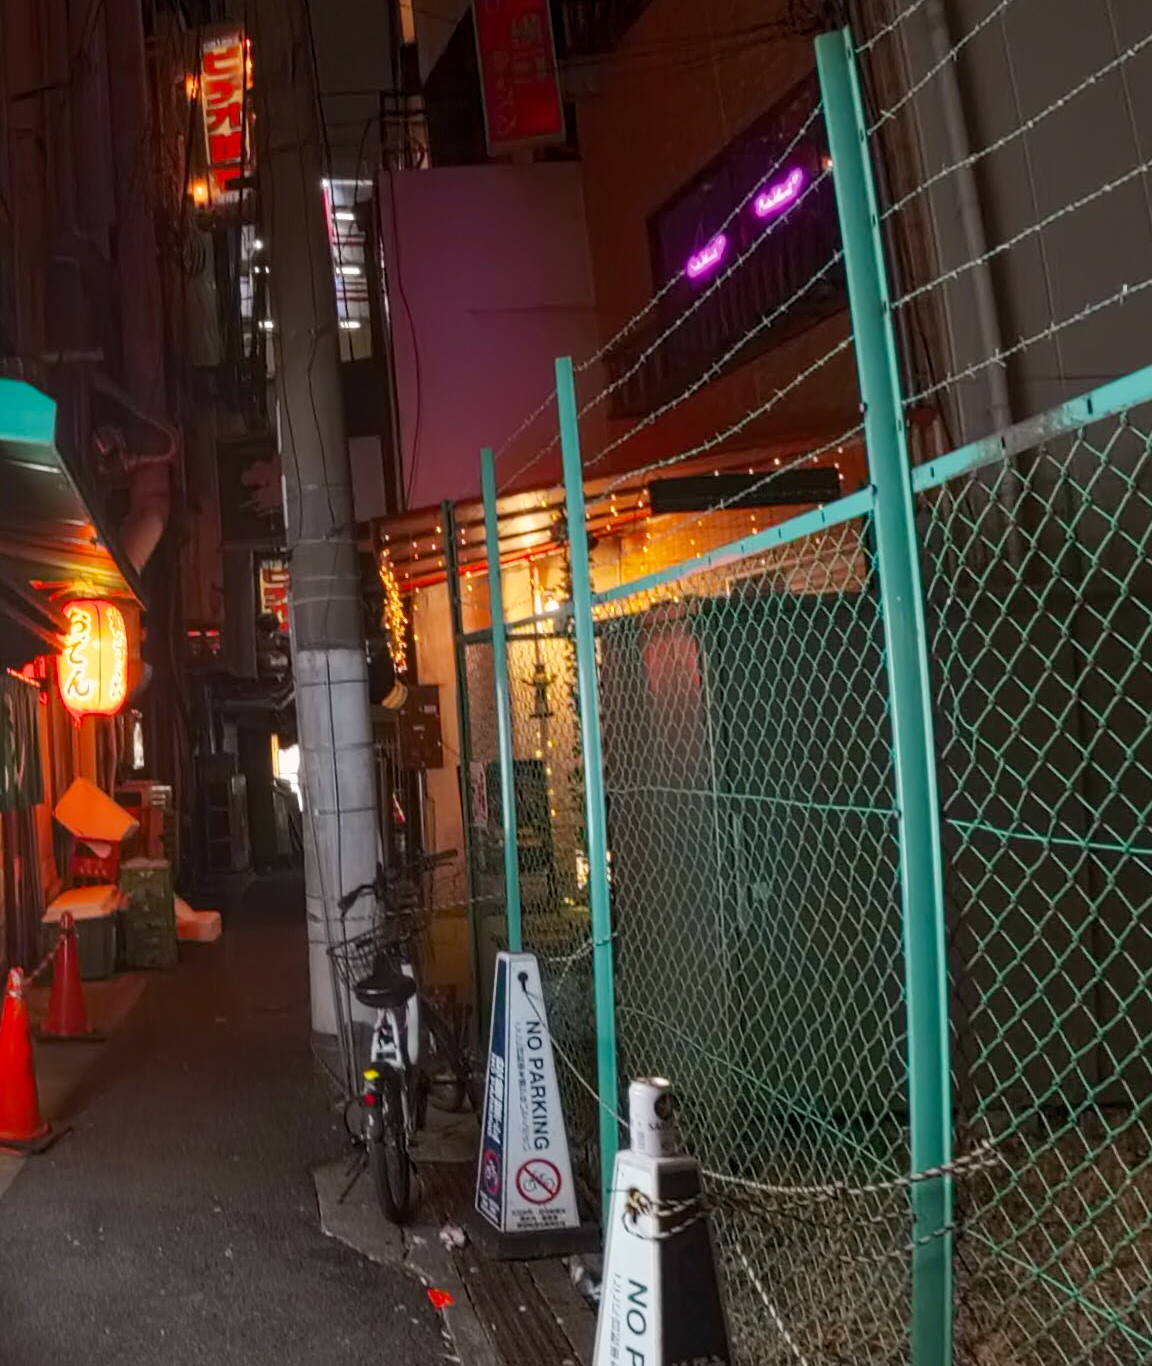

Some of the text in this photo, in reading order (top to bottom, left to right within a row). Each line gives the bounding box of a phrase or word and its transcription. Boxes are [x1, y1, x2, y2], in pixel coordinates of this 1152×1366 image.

[67, 607, 96, 701] おでん
[525, 1020, 550, 1151] NO PARKING
[627, 1278, 648, 1336] NO
